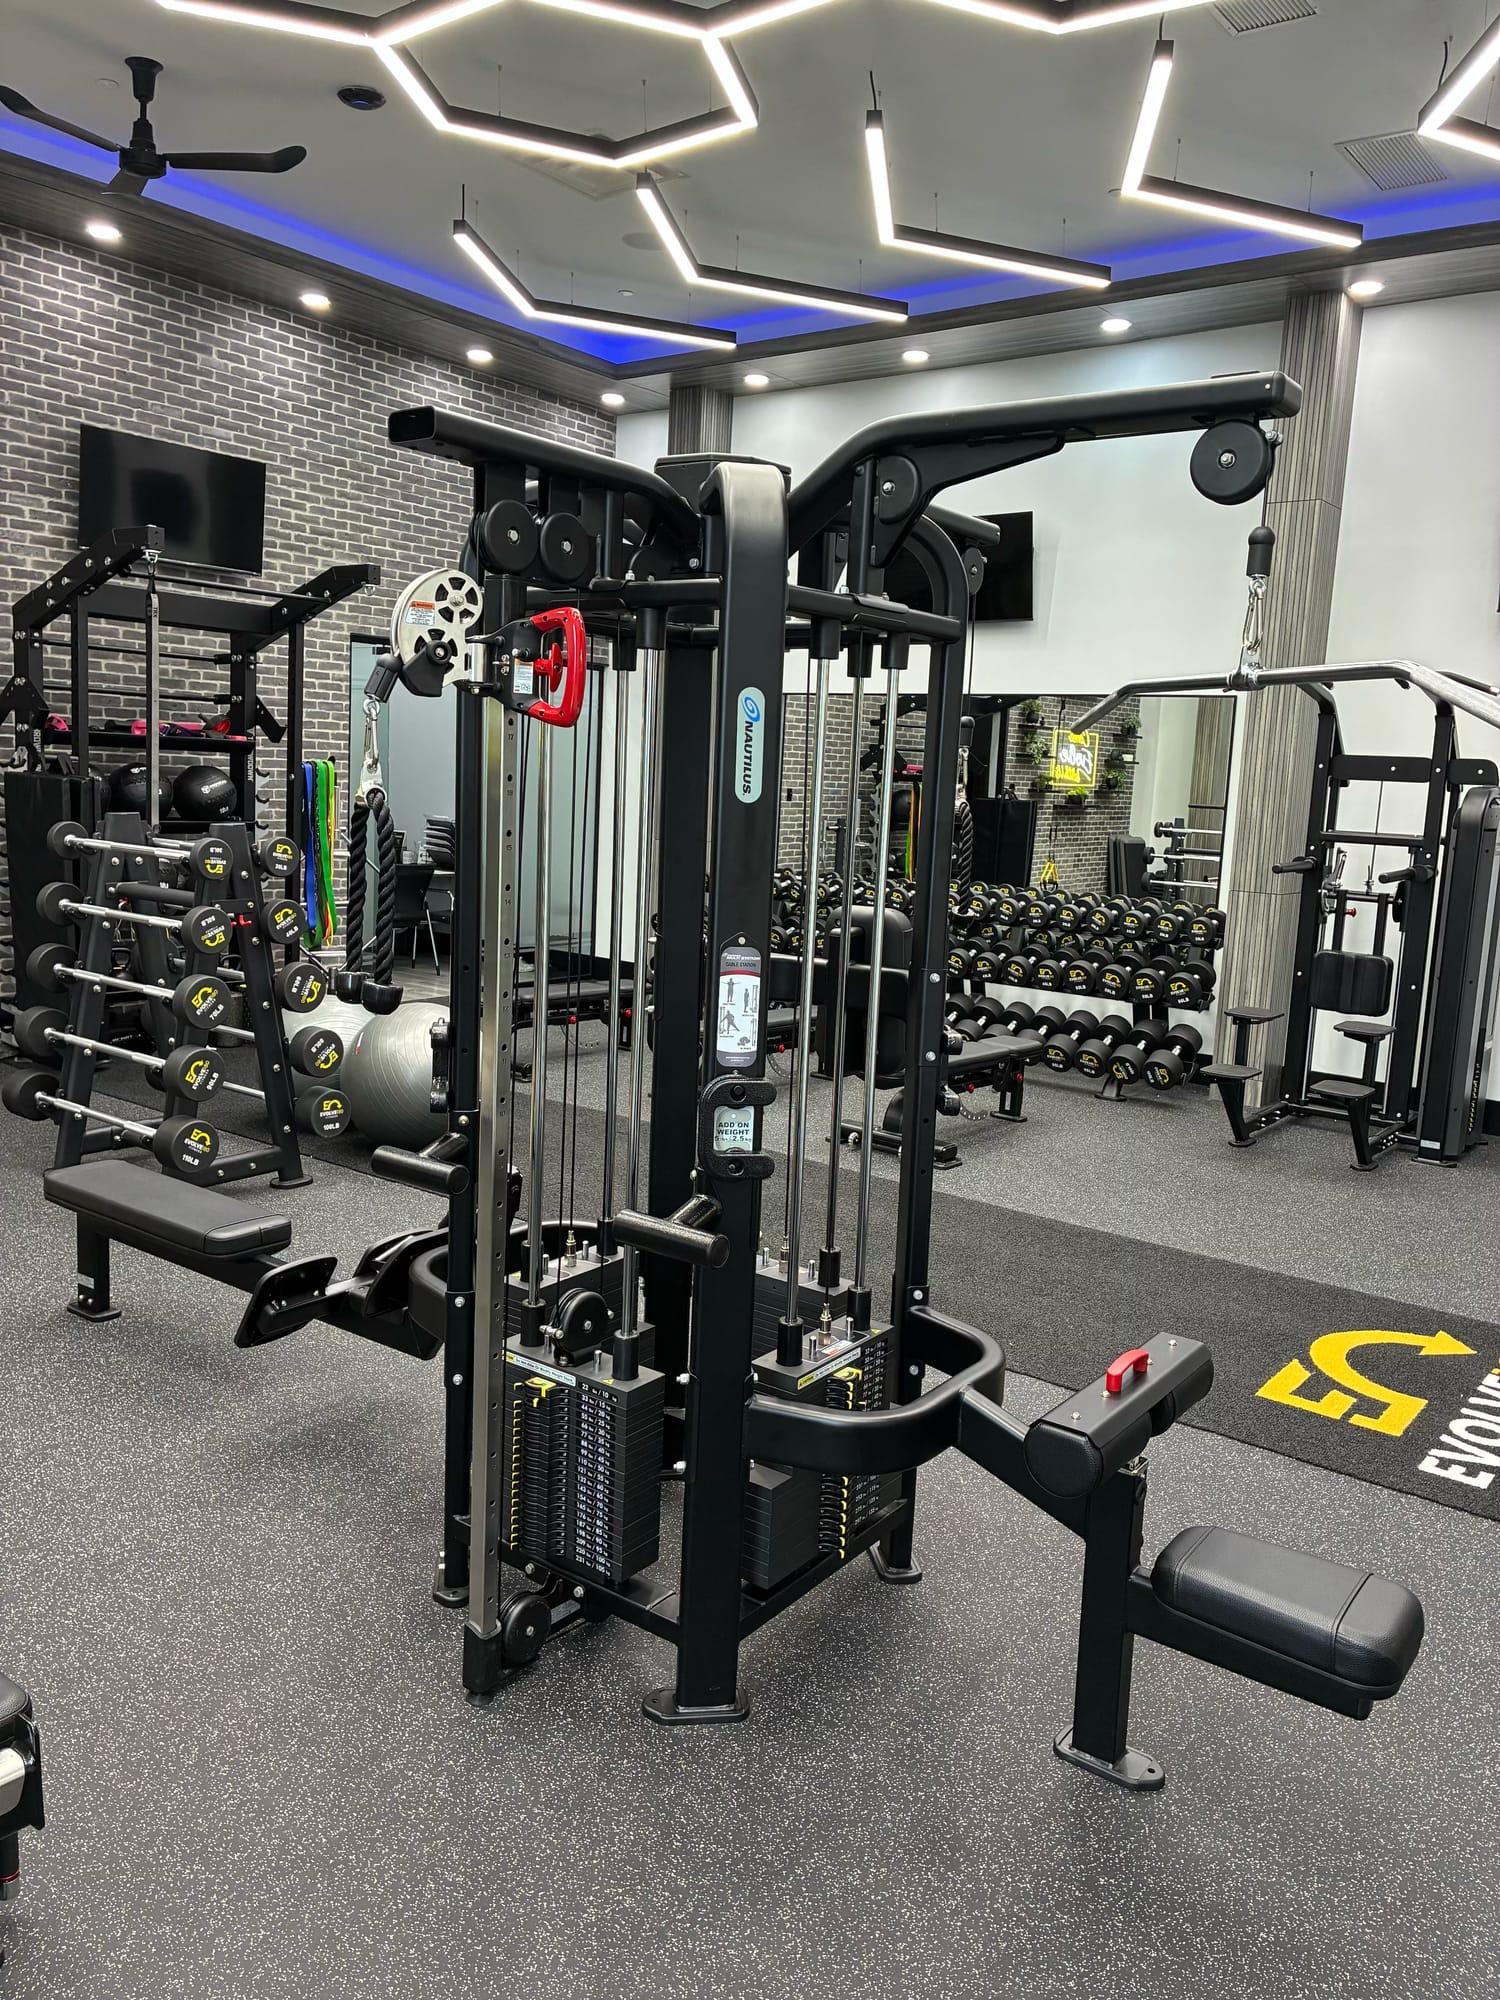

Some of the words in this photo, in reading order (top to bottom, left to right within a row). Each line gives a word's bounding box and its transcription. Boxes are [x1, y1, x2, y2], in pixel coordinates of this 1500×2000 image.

[742, 721, 753, 795] NAUTILUS
[209, 1004, 224, 1020] 70LB
[207, 1072, 219, 1090] 90LB
